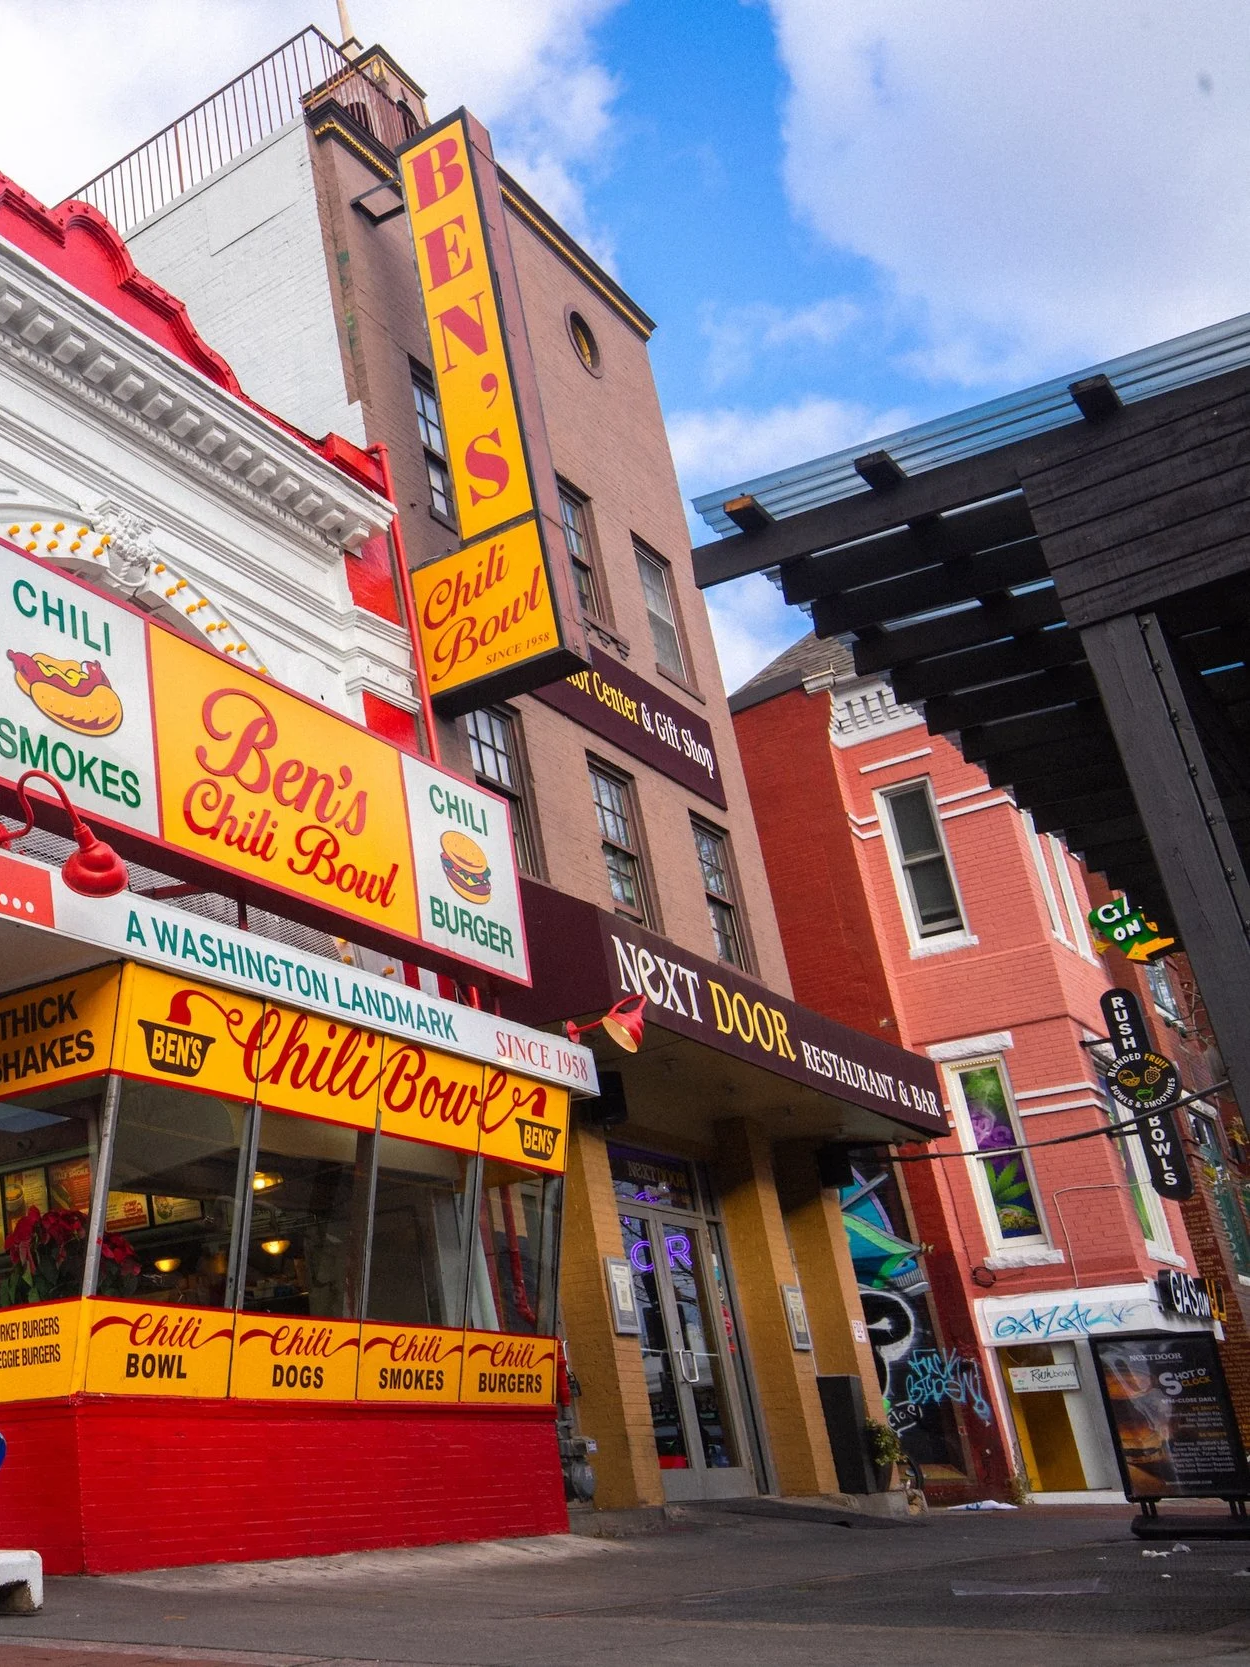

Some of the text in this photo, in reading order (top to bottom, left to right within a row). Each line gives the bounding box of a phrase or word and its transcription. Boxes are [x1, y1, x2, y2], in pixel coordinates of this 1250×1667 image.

[407, 136, 511, 507] BEN'S
[423, 543, 510, 631] Chili
[12, 578, 112, 657] CHILI
[432, 565, 545, 682] Bowl
[485, 630, 551, 667] SINCE 1958
[592, 671, 640, 725] Center
[640, 702, 655, 735] &
[654, 711, 682, 751] Gift
[681, 728, 715, 780] Shop
[196, 687, 368, 837] Ben's
[429, 783, 489, 836] CHILI
[182, 779, 401, 908] Chili Bowl
[429, 894, 515, 960] BURGER
[1113, 918, 1141, 941] ON
[125, 910, 460, 1042] A WASHINGTON LANDMARK
[707, 979, 797, 1062] DOOR
[801, 1040, 897, 1104] RESTAURANT
[897, 1079, 911, 1106] &
[910, 1083, 941, 1117] BAR
[1110, 995, 1137, 1051] RUSH
[150, 1028, 205, 1071] BEN'S
[238, 1005, 507, 1135] Chili Bowl
[496, 1030, 589, 1082] SINCE 1958
[1107, 1052, 1170, 1078] BLENDED FRUIT
[1110, 1076, 1176, 1110] BOWLS & SMOOTHIES
[522, 1125, 556, 1158] BEN'S
[1147, 1114, 1178, 1187] BOWLS
[21, 1315, 60, 1340] BURGERS
[20, 1343, 61, 1366] BURGERS
[125, 1353, 187, 1380] BOWL
[271, 1364, 324, 1389] DOGS
[378, 1367, 445, 1392] SMOKES
[478, 1372, 543, 1395] BURGERS
[1158, 1369, 1197, 1396] SHOT
[1181, 1375, 1212, 1387] CLOCK
